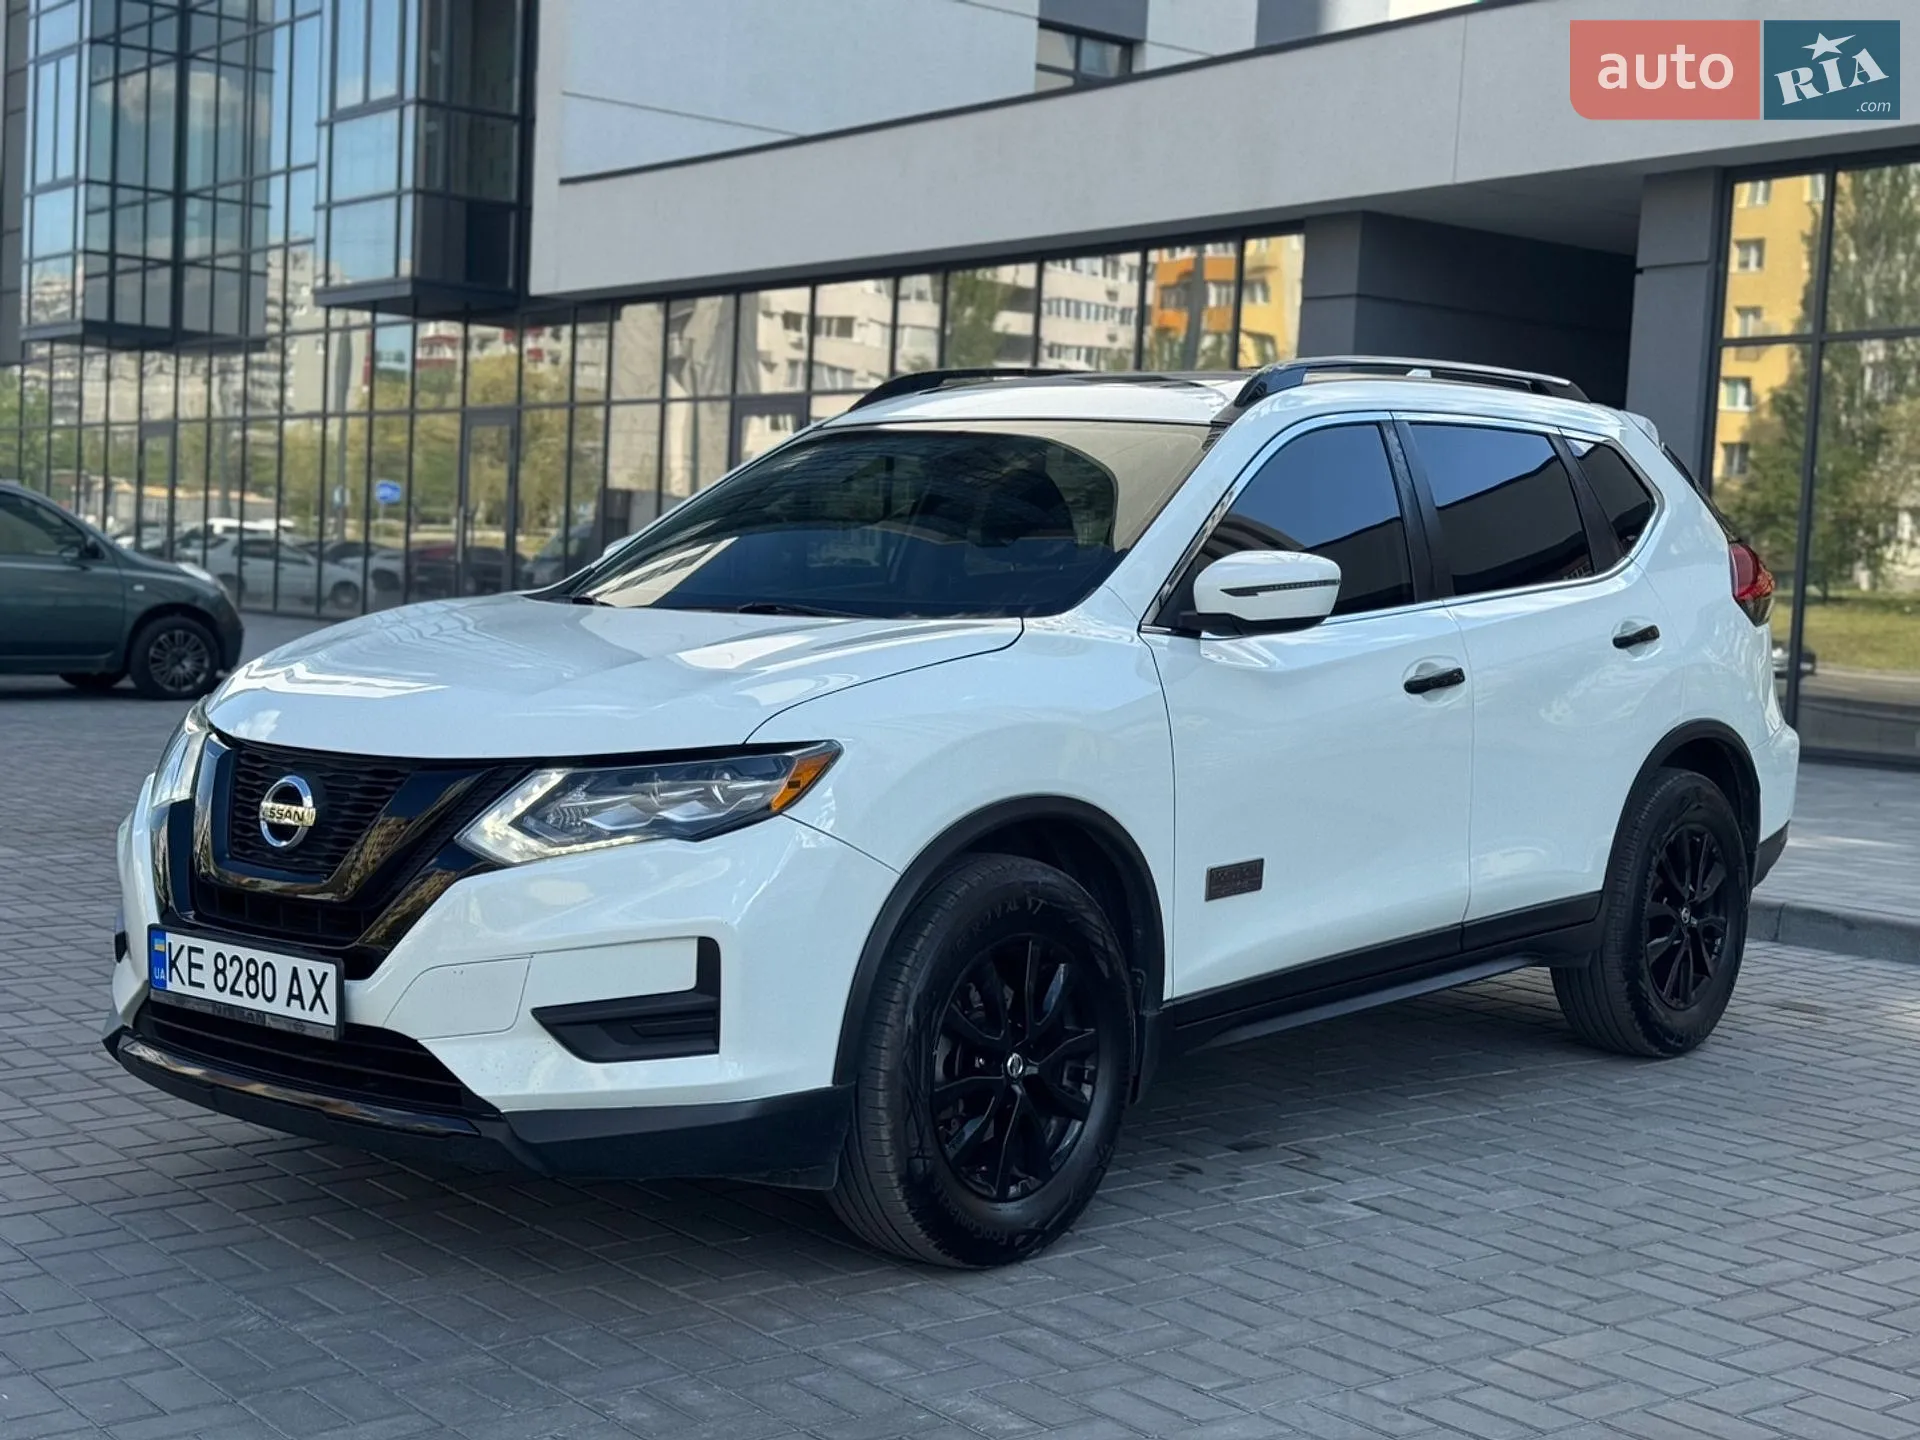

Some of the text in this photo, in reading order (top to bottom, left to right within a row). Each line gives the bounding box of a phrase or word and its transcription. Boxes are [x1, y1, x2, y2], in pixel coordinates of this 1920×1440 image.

[153, 967, 165, 980] UA
[168, 941, 329, 1015] KE 8280 AX
